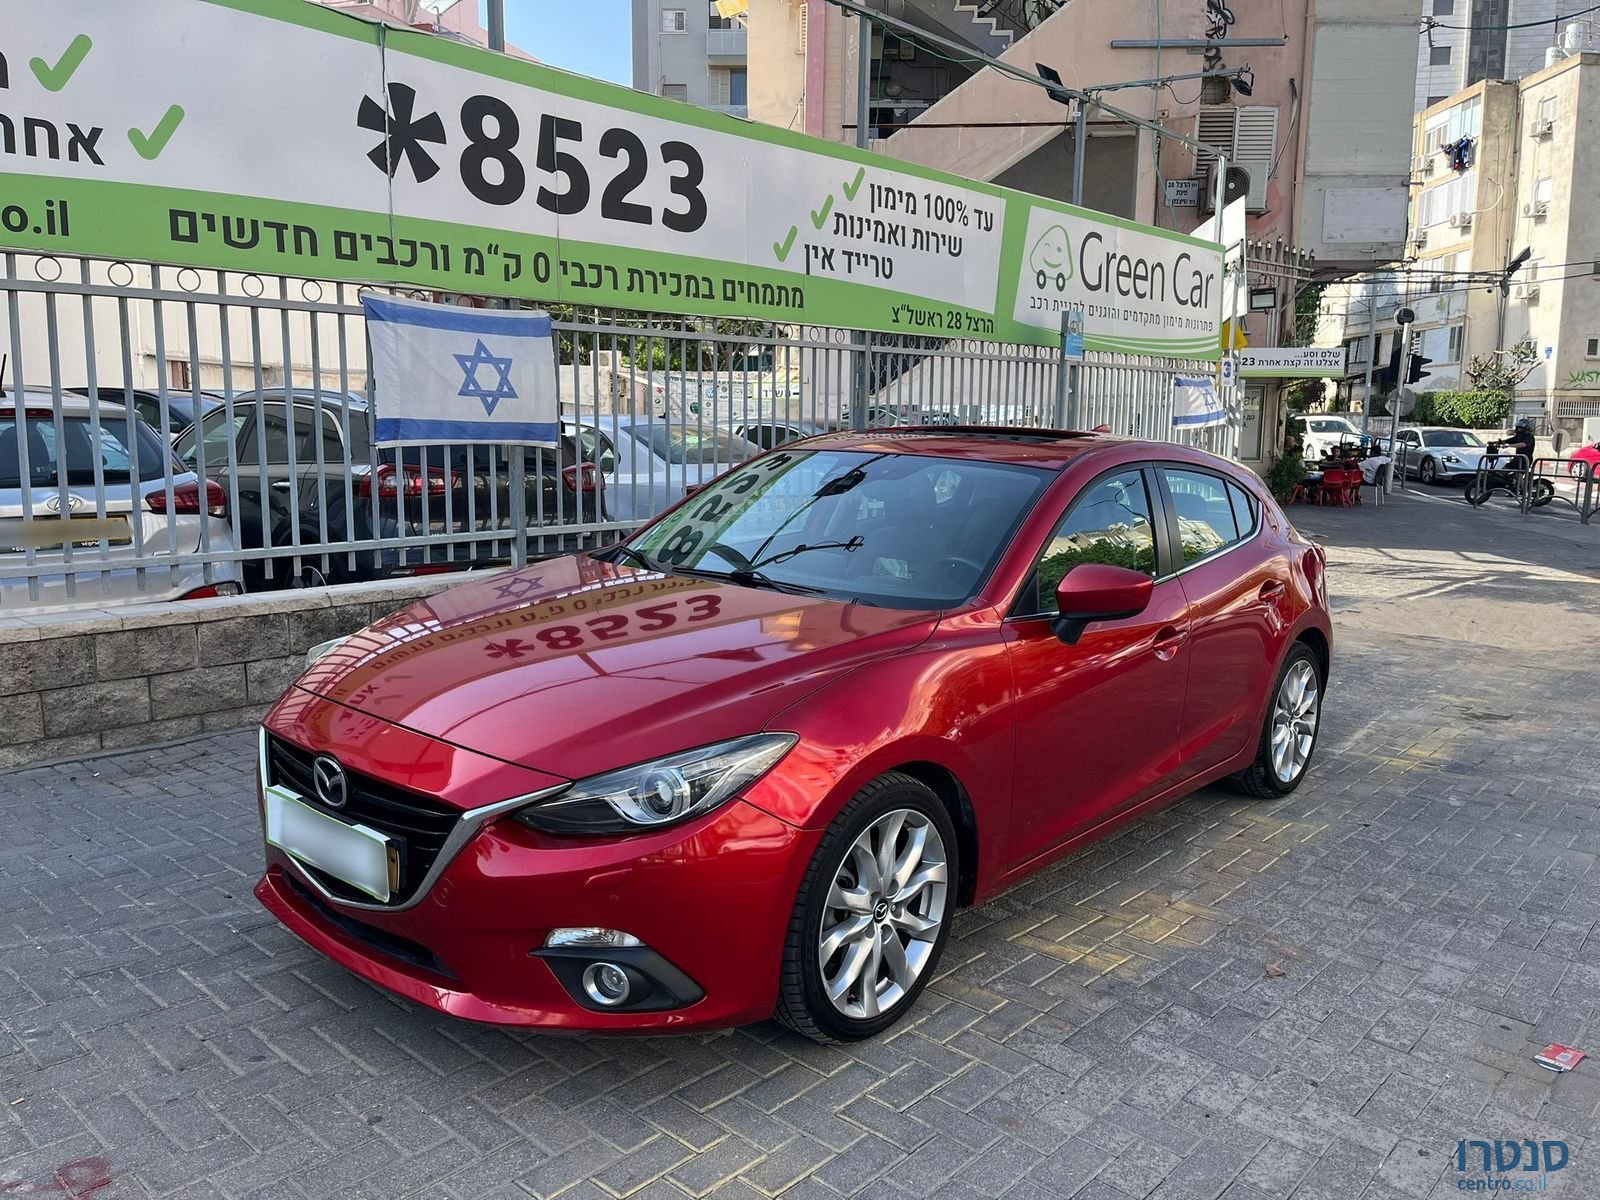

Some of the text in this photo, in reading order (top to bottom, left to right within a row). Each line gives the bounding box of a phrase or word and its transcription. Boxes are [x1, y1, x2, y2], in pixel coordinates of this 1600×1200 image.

[869, 183, 994, 232] עד 100% מימון
[169, 209, 318, 257] חדשים
[833, 211, 963, 257] שירות ואמינות
[334, 230, 450, 272] ורכבים
[804, 243, 894, 280] טרייד אין
[533, 252, 550, 283] 0
[559, 260, 618, 291] רכבי
[1080, 231, 1214, 310] Green Car
[627, 267, 715, 300] במכירת
[722, 278, 804, 309] מתמחים
[1030, 296, 1049, 310] רכב
[1088, 304, 1120, 320] והוגנים
[946, 310, 962, 330] 28
[965, 312, 994, 334] הרצל
[1123, 309, 1160, 326] מתקדמים
[1163, 315, 1183, 328] מימון
[1185, 318, 1214, 332] פתרונות
[1239, 357, 1255, 366] 23
[1258, 359, 1281, 367] אחרת
[1283, 359, 1301, 368] קצת
[1316, 359, 1340, 367] אצלנו
[1321, 350, 1340, 358] שלם
